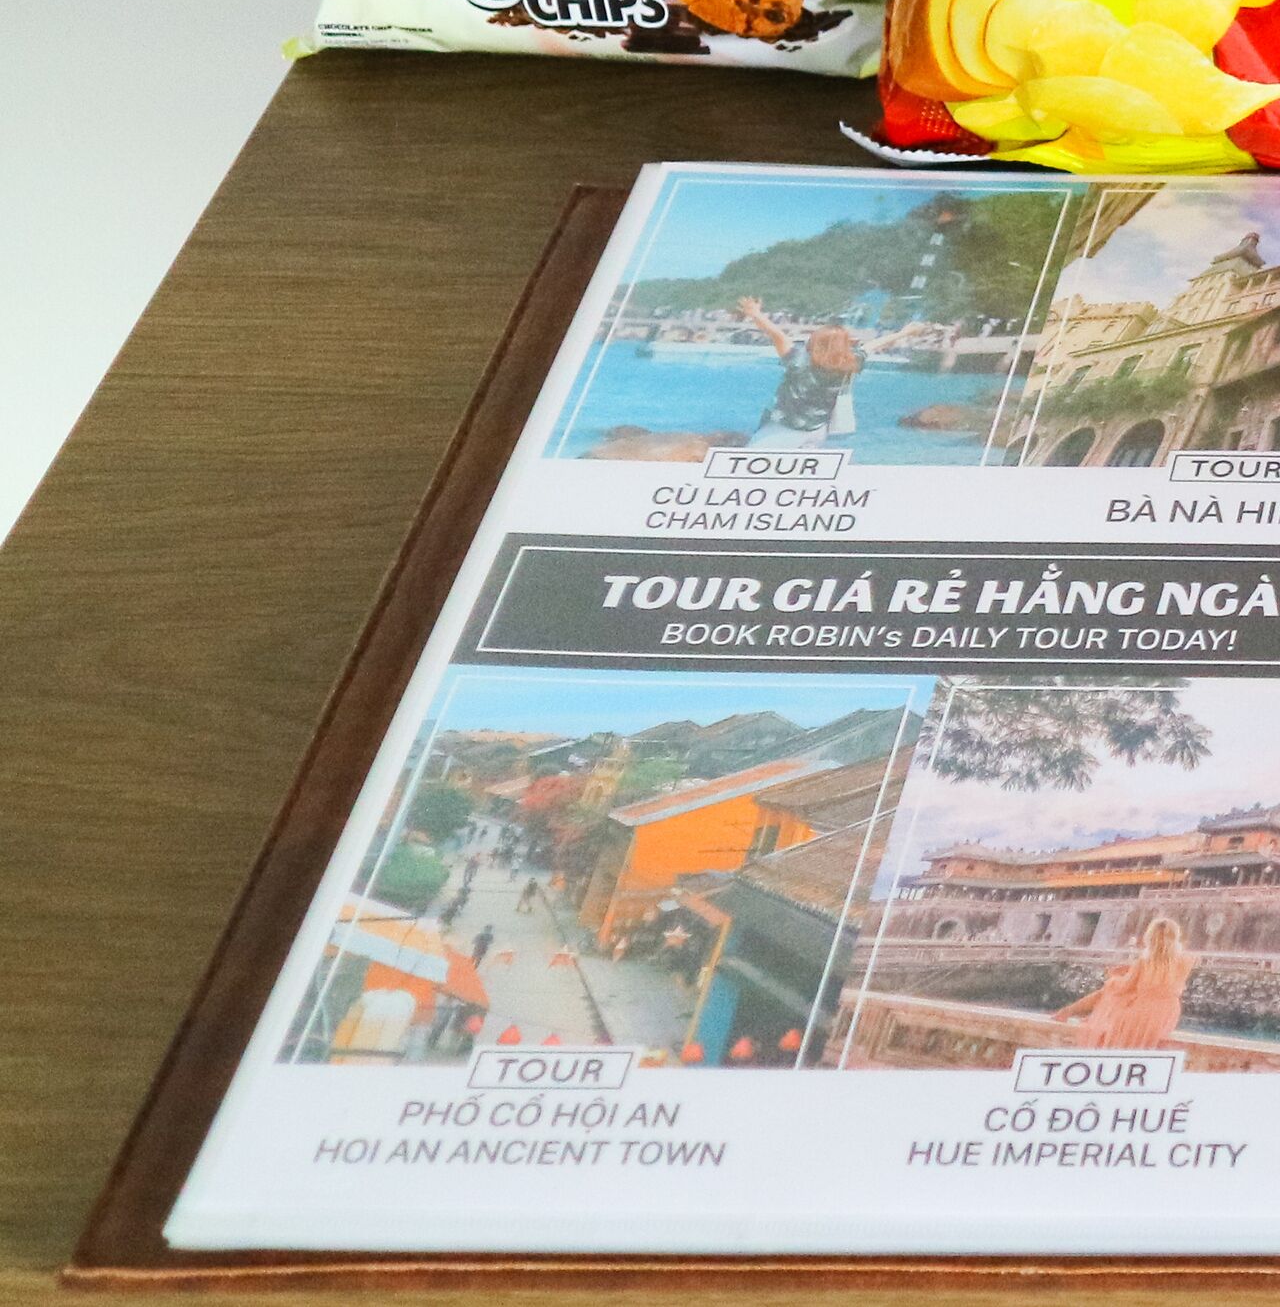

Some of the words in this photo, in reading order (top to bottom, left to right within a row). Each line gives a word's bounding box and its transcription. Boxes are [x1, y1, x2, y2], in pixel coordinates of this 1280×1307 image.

[729, 456, 820, 476] TOUR
[651, 483, 699, 506] CÙ
[704, 486, 768, 508] LAO
[774, 486, 871, 509] CHÀM
[1104, 493, 1158, 524] BÀ
[1159, 494, 1224, 525] NÀ
[645, 511, 738, 531] CHAM
[744, 512, 857, 533] ISLAND
[601, 573, 763, 612] TOUR
[772, 569, 875, 614] GIÁ
[887, 568, 967, 615] RẺ
[974, 561, 1147, 617] HẰNG
[660, 622, 762, 646] BOOK
[764, 623, 903, 649] ROBIN's
[910, 625, 1009, 651] DAILY
[1015, 627, 1109, 650] TOUR
[1117, 628, 1239, 653] TODAY!
[496, 1057, 606, 1085] TOUR
[1039, 1061, 1149, 1088] TOUR
[397, 1093, 486, 1129] PHỐ
[551, 1098, 619, 1135] HỘI
[622, 1102, 683, 1129] AN
[1045, 1102, 1100, 1134] ĐÔ
[1109, 1099, 1195, 1135] HUẾ
[312, 1138, 383, 1166] HOI
[385, 1138, 443, 1166] AN
[447, 1139, 609, 1167] ANCIENT
[618, 1140, 727, 1167] TOWN
[905, 1141, 983, 1167] HUE
[991, 1141, 1157, 1168] IMPERIAL
[1167, 1142, 1248, 1169] CITY
